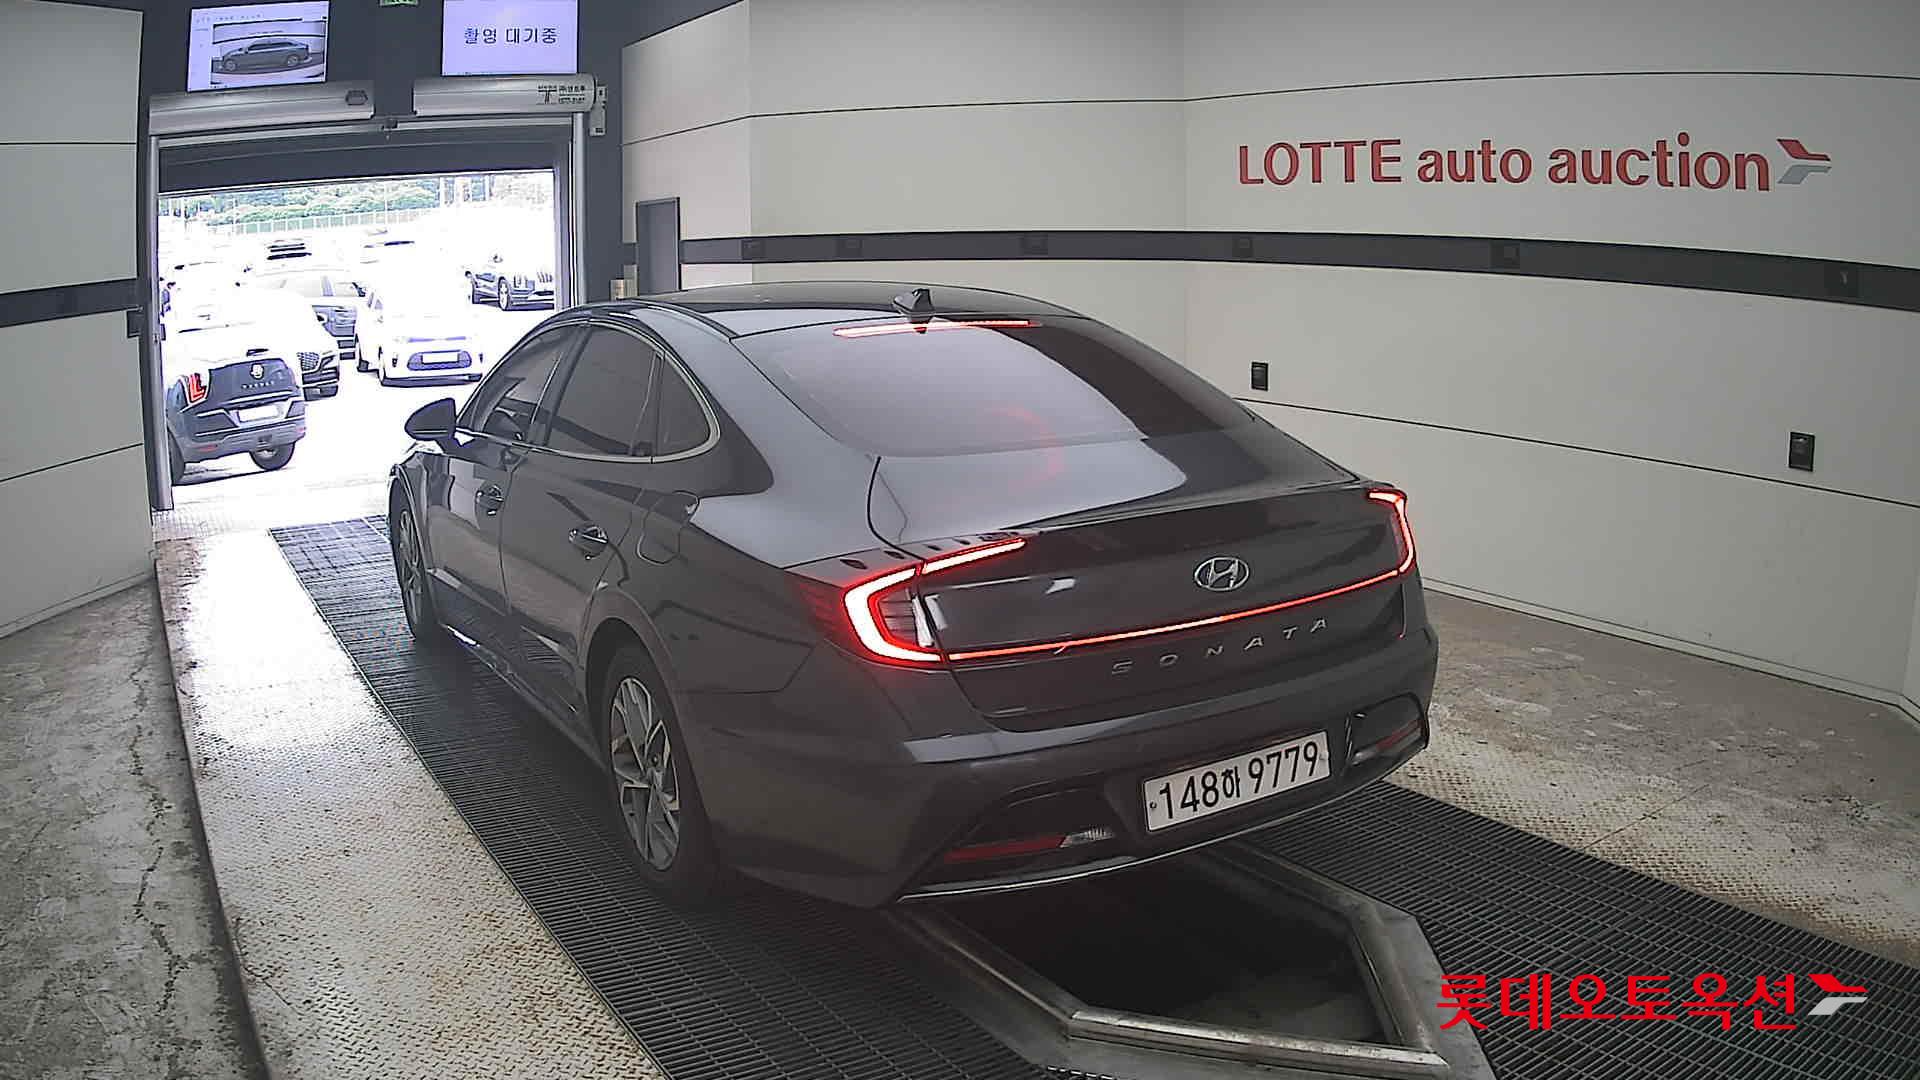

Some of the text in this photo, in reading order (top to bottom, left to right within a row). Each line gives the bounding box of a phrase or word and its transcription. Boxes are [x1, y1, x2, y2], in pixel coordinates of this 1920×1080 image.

[506, 27, 558, 44] 대기중
[1239, 132, 1771, 191] LOTTE auto auction
[1111, 616, 1328, 676] SONATA
[1247, 741, 1319, 794] 9779
